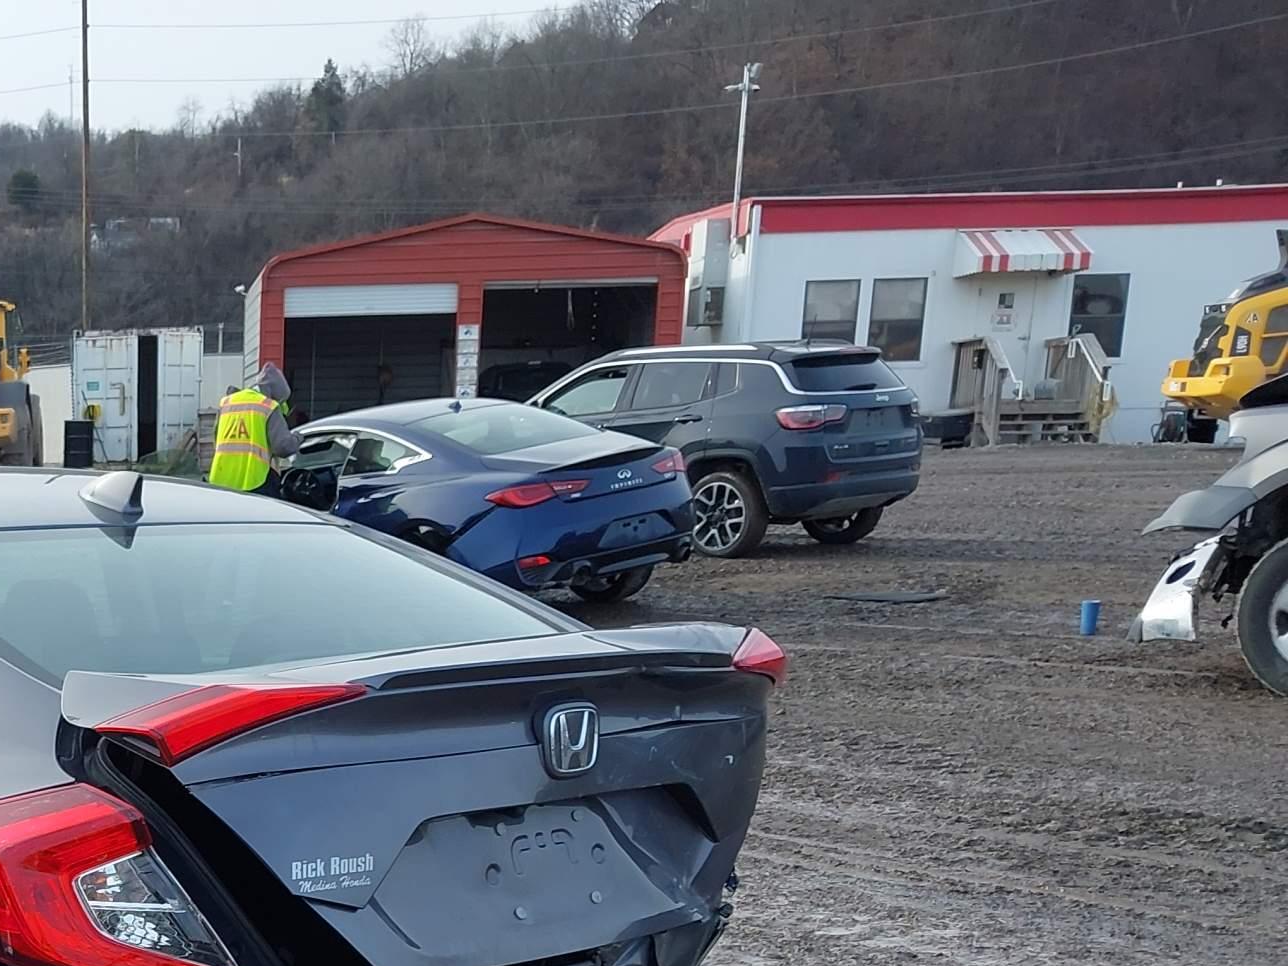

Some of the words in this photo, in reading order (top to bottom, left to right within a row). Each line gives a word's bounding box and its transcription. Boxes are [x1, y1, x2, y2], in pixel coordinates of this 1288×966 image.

[291, 858, 325, 880] Rick
[330, 853, 374, 875] Roush
[298, 880, 337, 893] Medina
[339, 875, 372, 889] Honda
